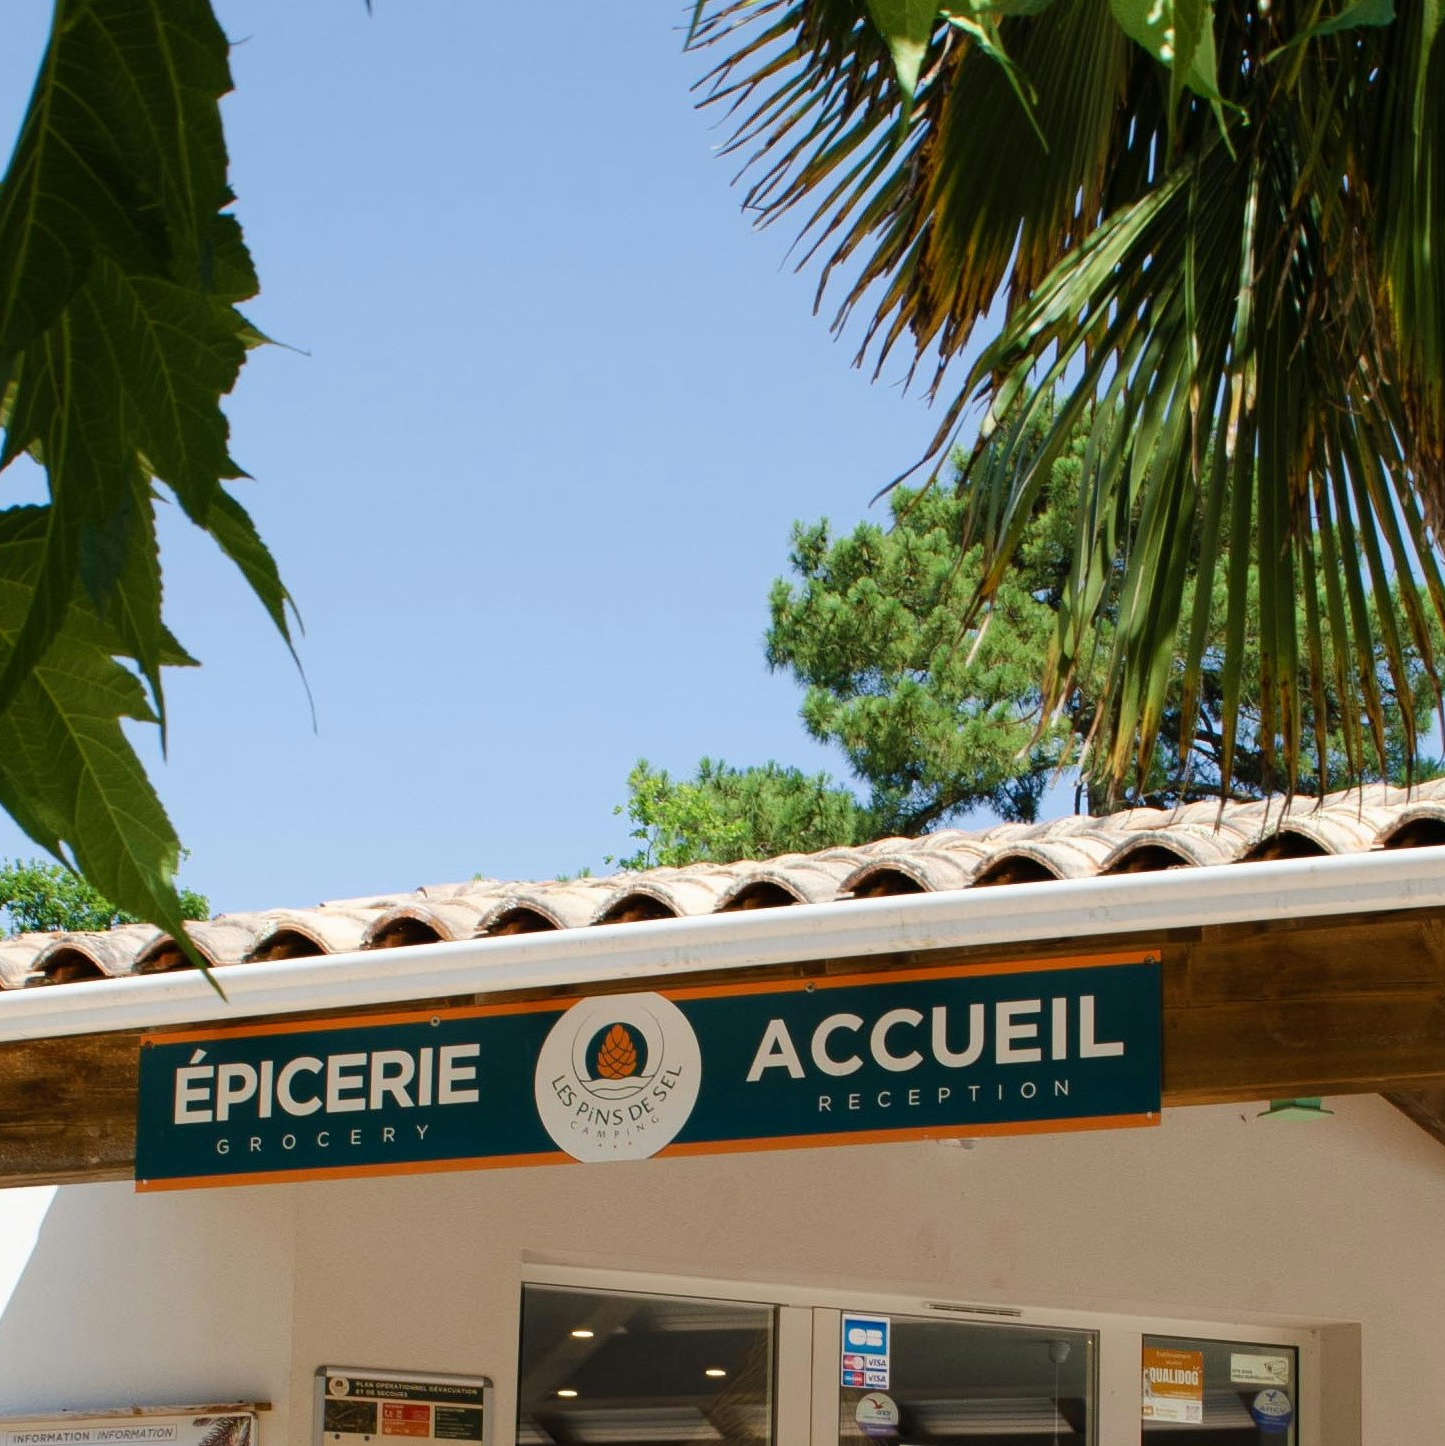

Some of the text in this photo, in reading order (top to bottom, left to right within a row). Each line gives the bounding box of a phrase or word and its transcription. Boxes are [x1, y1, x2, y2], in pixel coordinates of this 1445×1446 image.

[174, 995, 1124, 1125] ÉPICERIE ACCUEIL
[552, 1075, 577, 1107] LES
[629, 1097, 654, 1121] DE
[653, 1065, 683, 1102] SEL
[217, 1080, 1070, 1154] GROCERY RECEPTION
[570, 1116, 660, 1139] CAMPING
[868, 1359, 886, 1367] VISA
[868, 1374, 886, 1383] VISA
[1149, 1367, 1199, 1385] QUALIDOG
[13, 1428, 173, 1444] INFORMATION INFORMATION
